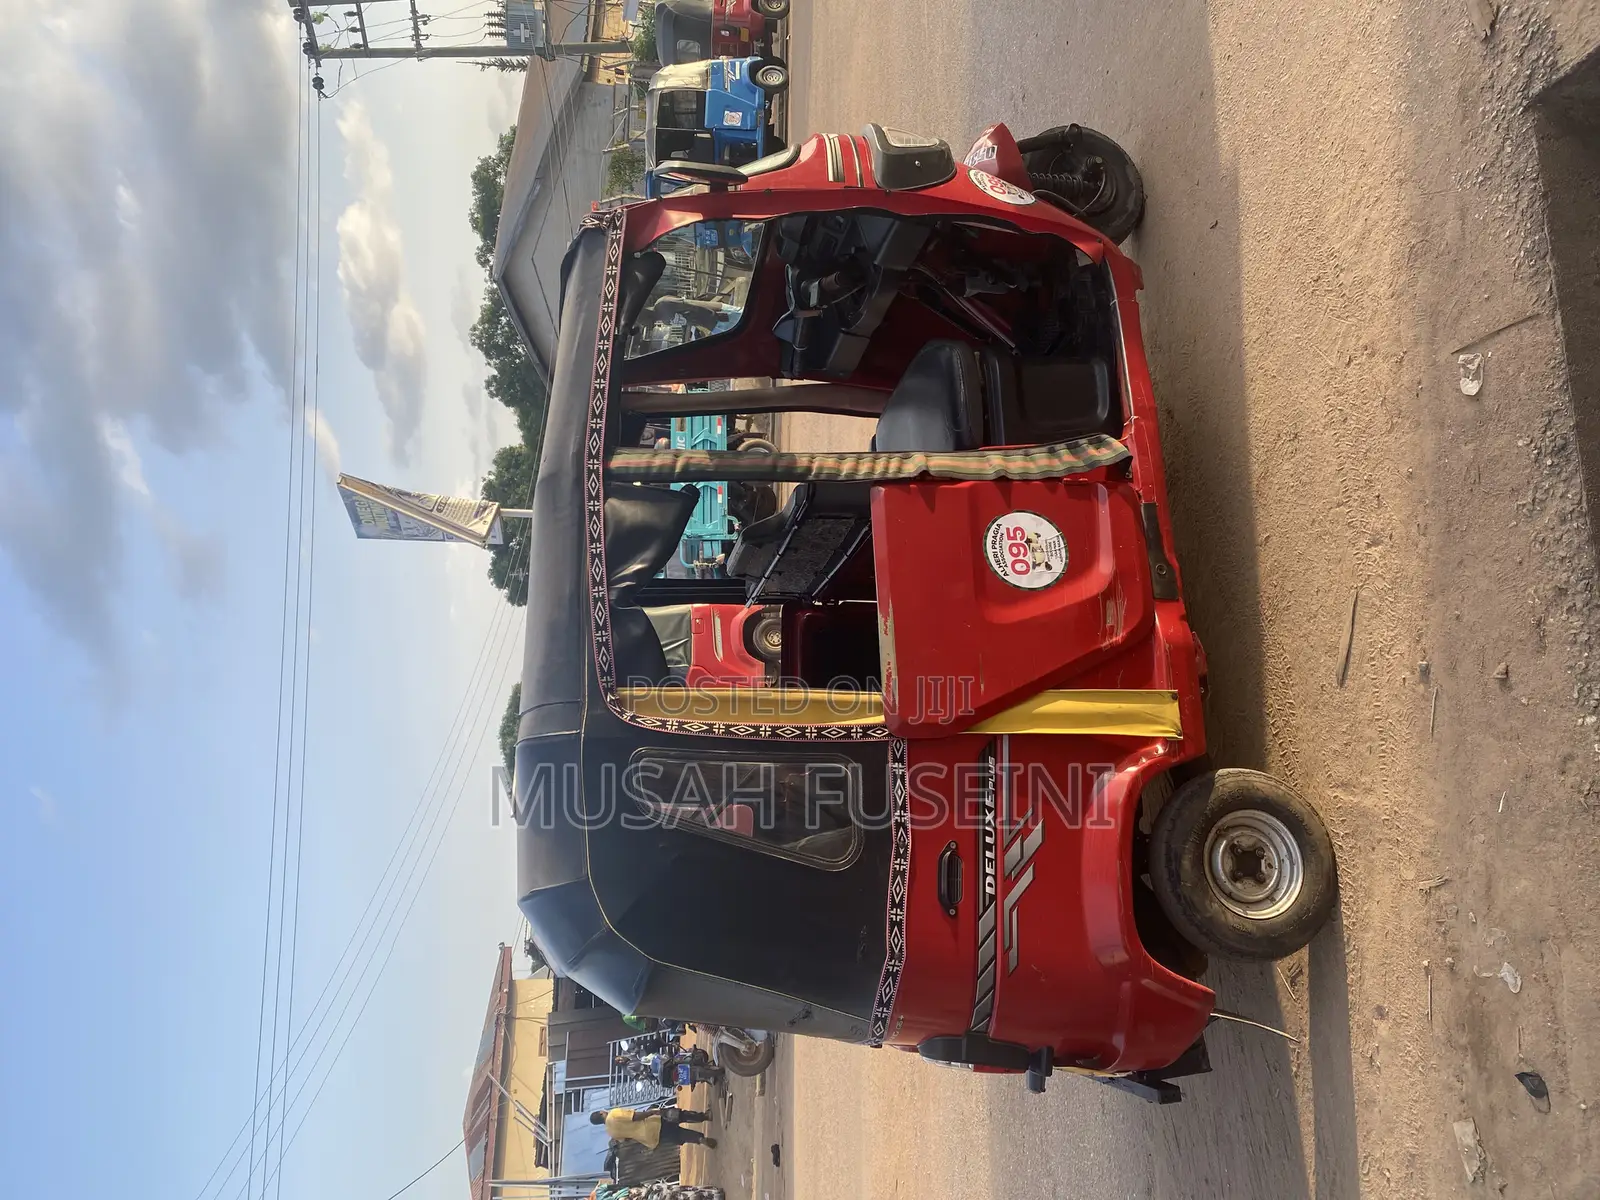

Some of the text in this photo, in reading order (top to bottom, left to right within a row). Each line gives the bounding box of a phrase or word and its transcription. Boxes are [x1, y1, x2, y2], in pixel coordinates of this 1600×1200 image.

[992, 524, 1009, 577] ALHERI PRAGIA
[998, 533, 1008, 568] ASSOCIATION
[1006, 526, 1030, 575] 095
[985, 791, 996, 895] DELUXE
